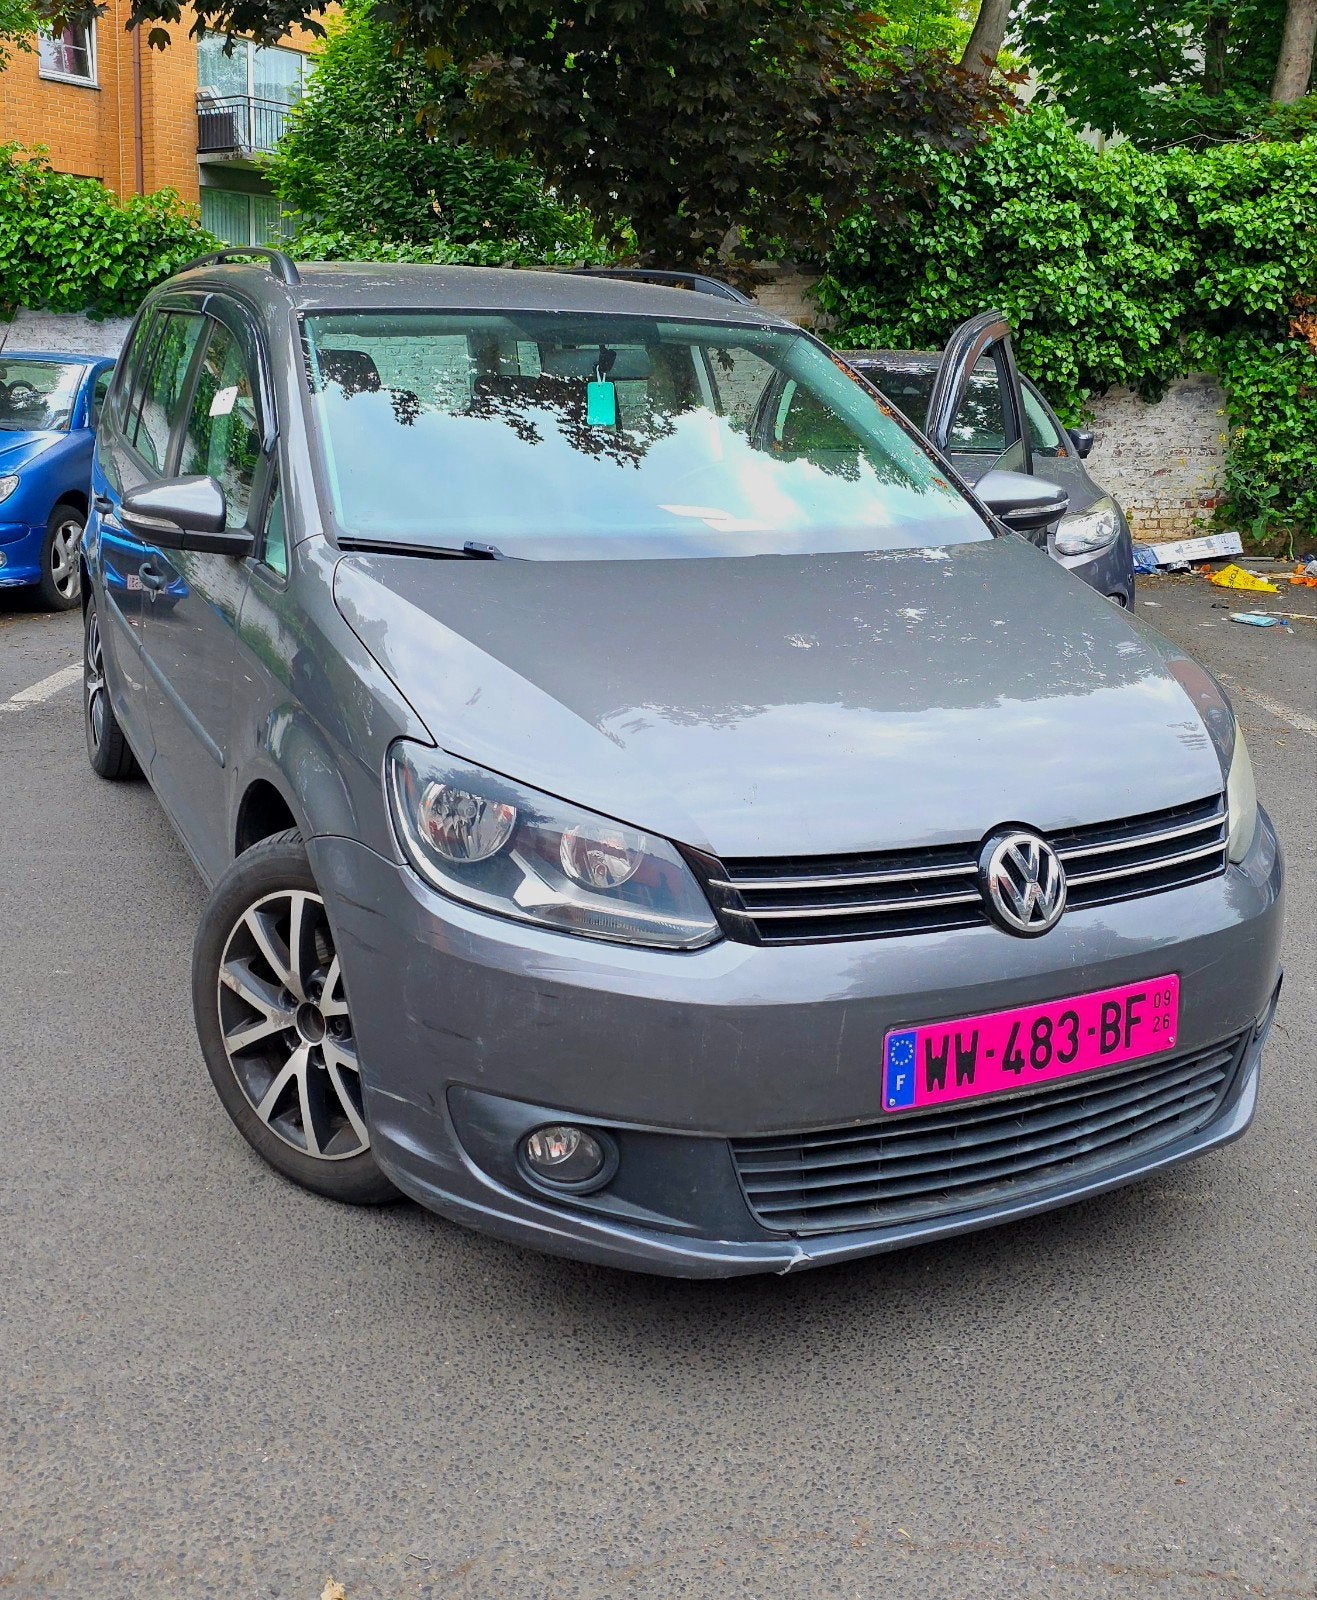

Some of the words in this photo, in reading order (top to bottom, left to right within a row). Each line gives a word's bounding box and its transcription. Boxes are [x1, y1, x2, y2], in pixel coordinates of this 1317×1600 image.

[1154, 989, 1171, 1009] 09
[1153, 1013, 1170, 1033] 26
[925, 993, 1147, 1093] WW-483-BF
[896, 1074, 906, 1091] F
